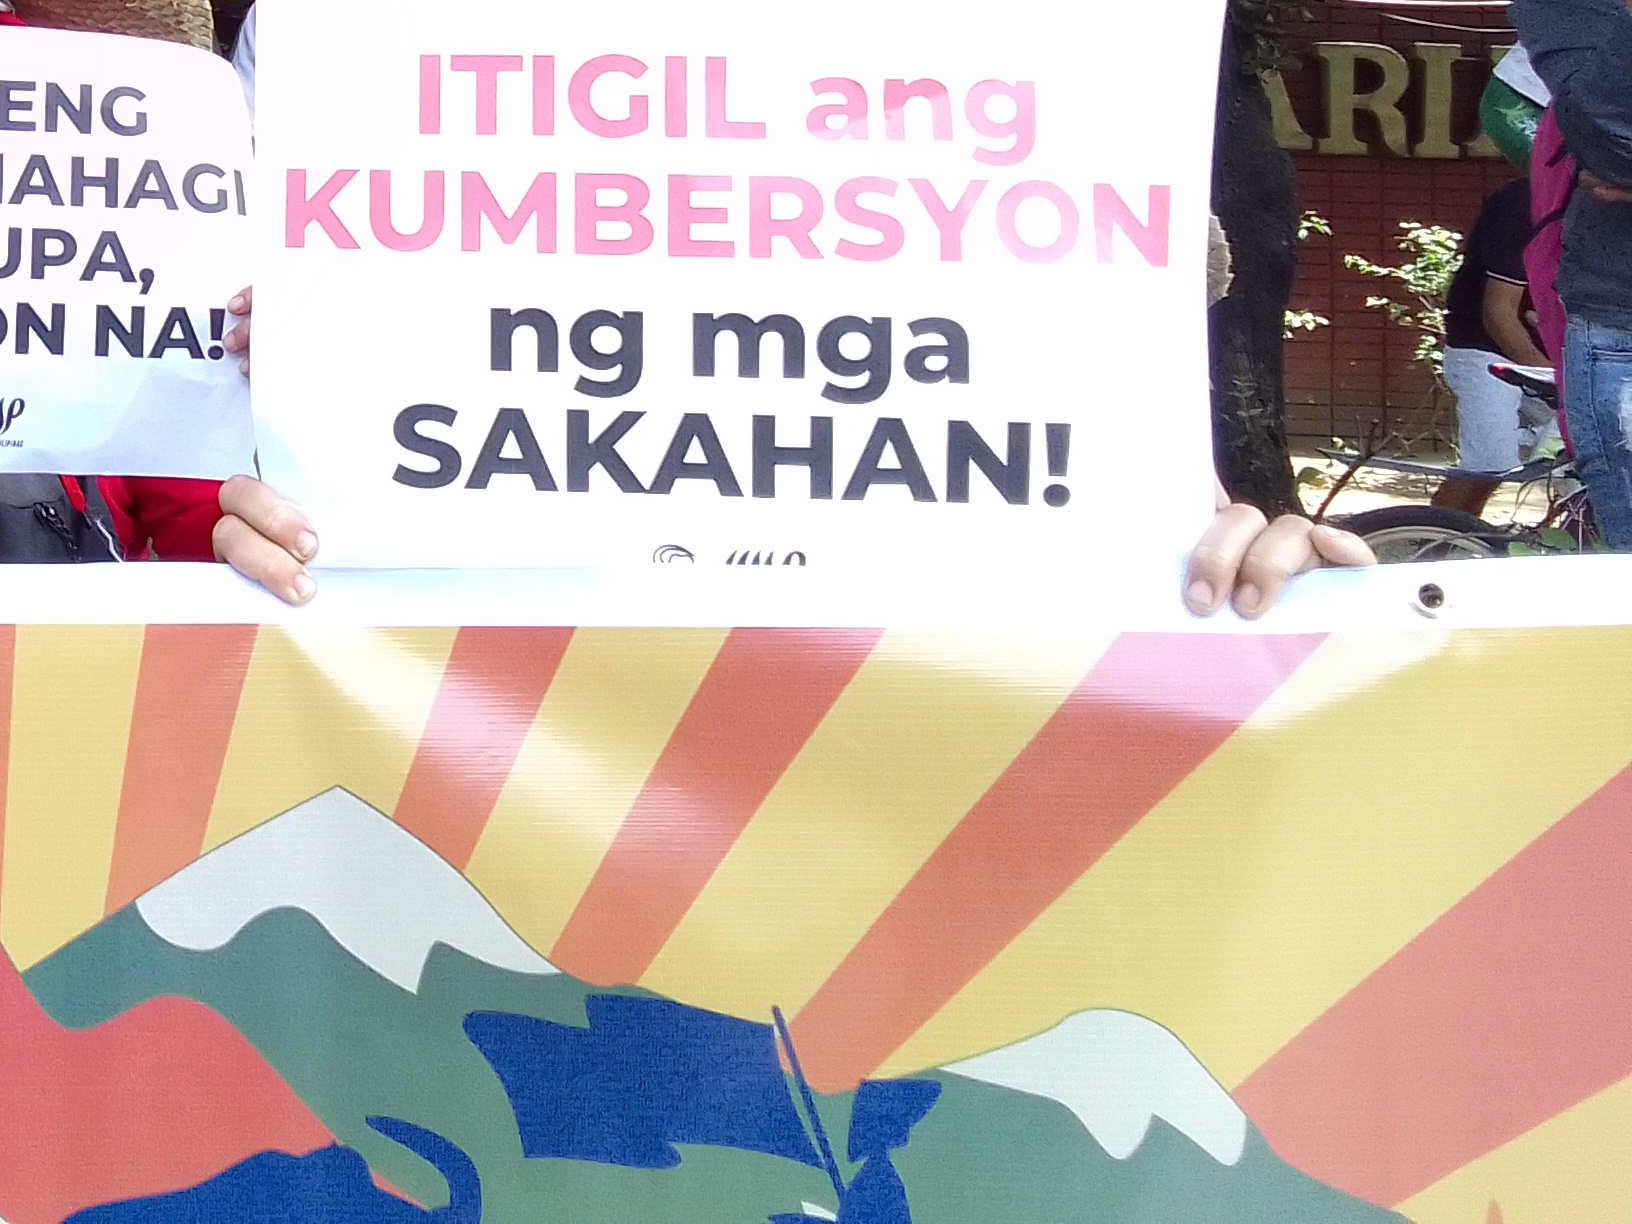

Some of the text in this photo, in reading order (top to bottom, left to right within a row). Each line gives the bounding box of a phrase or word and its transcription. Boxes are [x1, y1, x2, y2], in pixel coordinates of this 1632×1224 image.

[417, 53, 1036, 167] ITIGIL ang
[284, 167, 1171, 268] KUMBERSYON
[93, 304, 225, 360] NA!
[489, 305, 970, 404] ng mga
[391, 403, 1071, 508] SAKAHAN!
